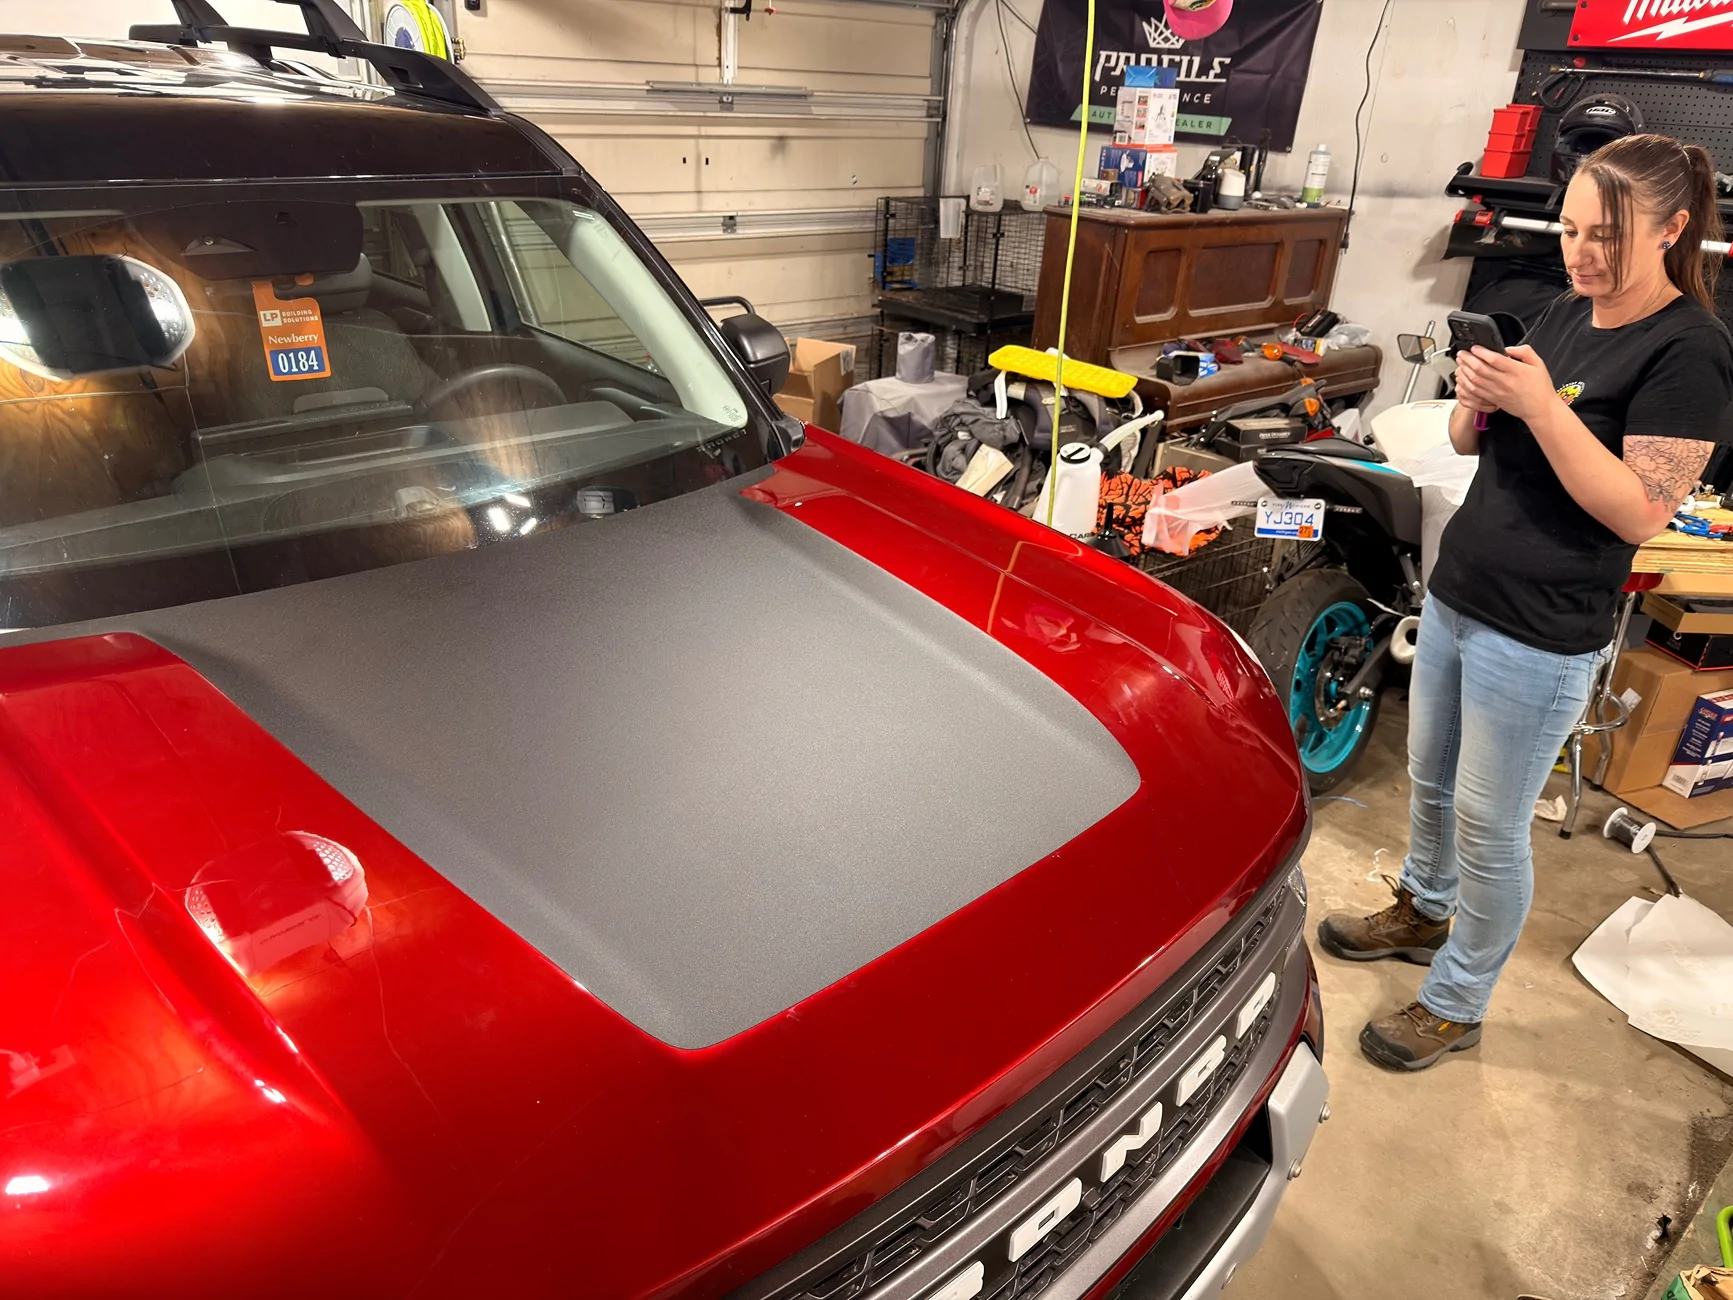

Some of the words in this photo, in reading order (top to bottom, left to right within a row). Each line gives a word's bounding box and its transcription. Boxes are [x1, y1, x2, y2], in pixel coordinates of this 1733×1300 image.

[1175, 119, 1213, 129] EALER
[263, 313, 278, 322] LP
[282, 315, 319, 324] SOLUTIONS
[268, 333, 319, 345] Newberry
[278, 350, 319, 373] 0184
[1265, 511, 1314, 526] YJ304
